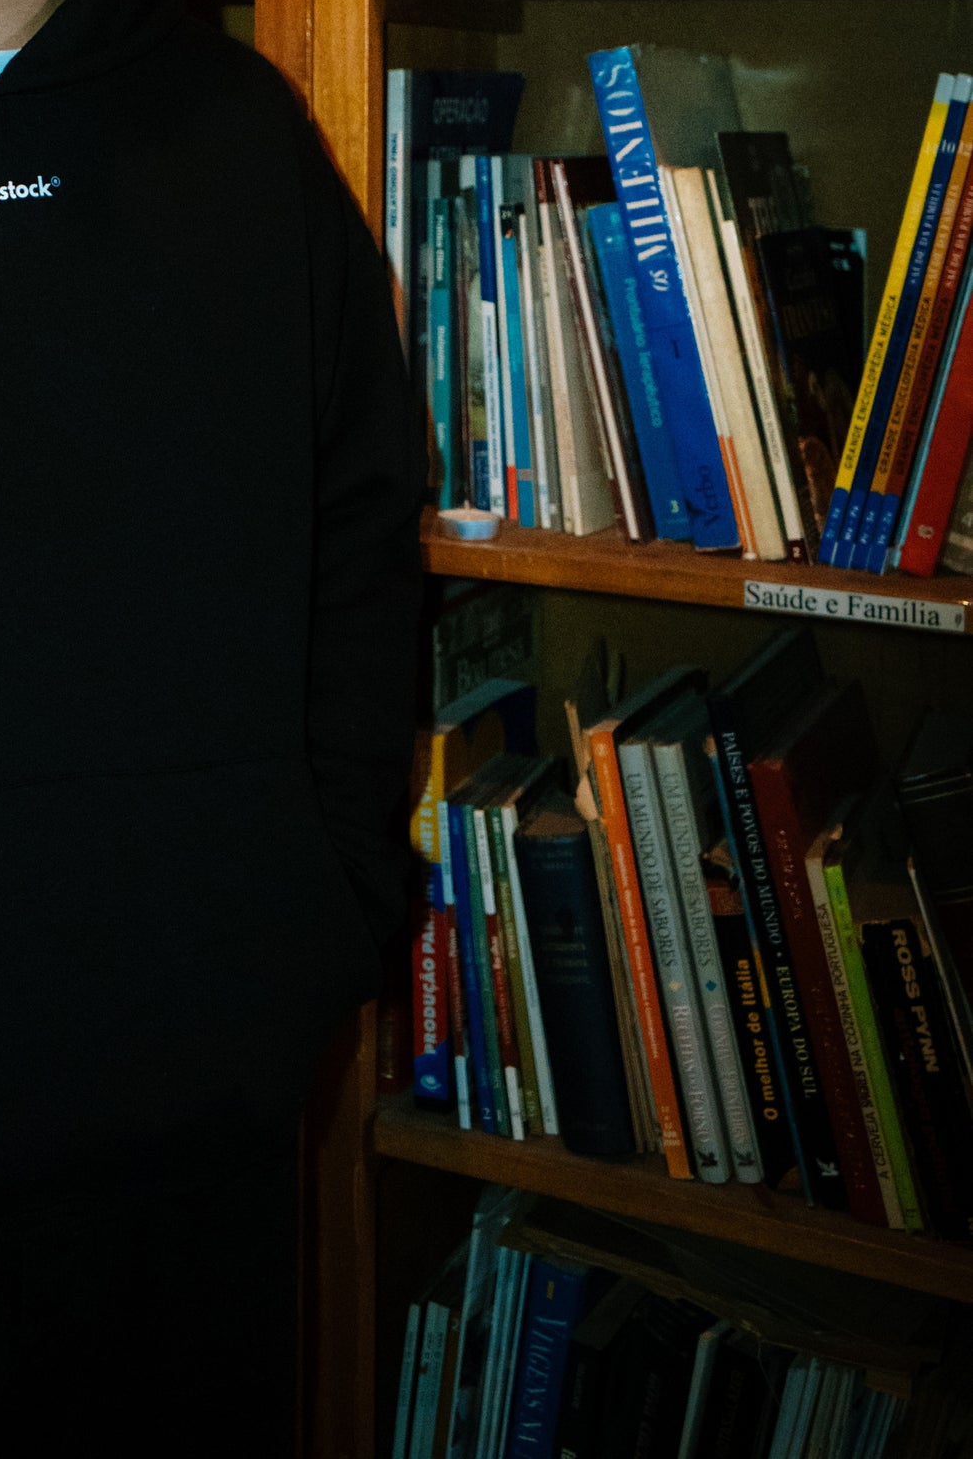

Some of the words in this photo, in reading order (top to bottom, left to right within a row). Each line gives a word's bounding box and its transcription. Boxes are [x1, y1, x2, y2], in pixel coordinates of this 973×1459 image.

[941, 138, 957, 154] 10
[842, 425, 862, 469] GRANDE
[877, 293, 897, 336] MÉDICA
[878, 430, 897, 474] GRANDE
[747, 582, 818, 612] Saúde
[826, 597, 839, 615] e
[847, 595, 940, 627] Família
[719, 730, 747, 784] PAÍSES
[626, 772, 646, 803] UM
[733, 786, 749, 799] E
[632, 804, 659, 869] MUNDO
[736, 801, 762, 853] POVOS
[645, 871, 662, 892] DE
[666, 803, 695, 869] MUNDO
[685, 897, 715, 967] SABORES
[749, 857, 767, 881] DO
[648, 897, 678, 967] SABORES
[754, 883, 783, 946] MUNDO
[815, 902, 844, 986] PORTUGUESA
[891, 926, 923, 999] ROSS
[420, 953, 440, 1056] PRODUÇÃO
[733, 957, 756, 1006] Itália
[773, 963, 804, 1033] EUROPA
[743, 1010, 762, 1034] de
[835, 988, 858, 1046] COZINHA
[904, 1001, 940, 1075] PYNN
[750, 1036, 775, 1102] melhor
[791, 1036, 809, 1062] DO
[849, 1049, 863, 1068] NA
[798, 1065, 818, 1099] SUL
[762, 1105, 779, 1121] O
[864, 1111, 887, 1167] CERVEJA
[877, 1169, 889, 1179] A
